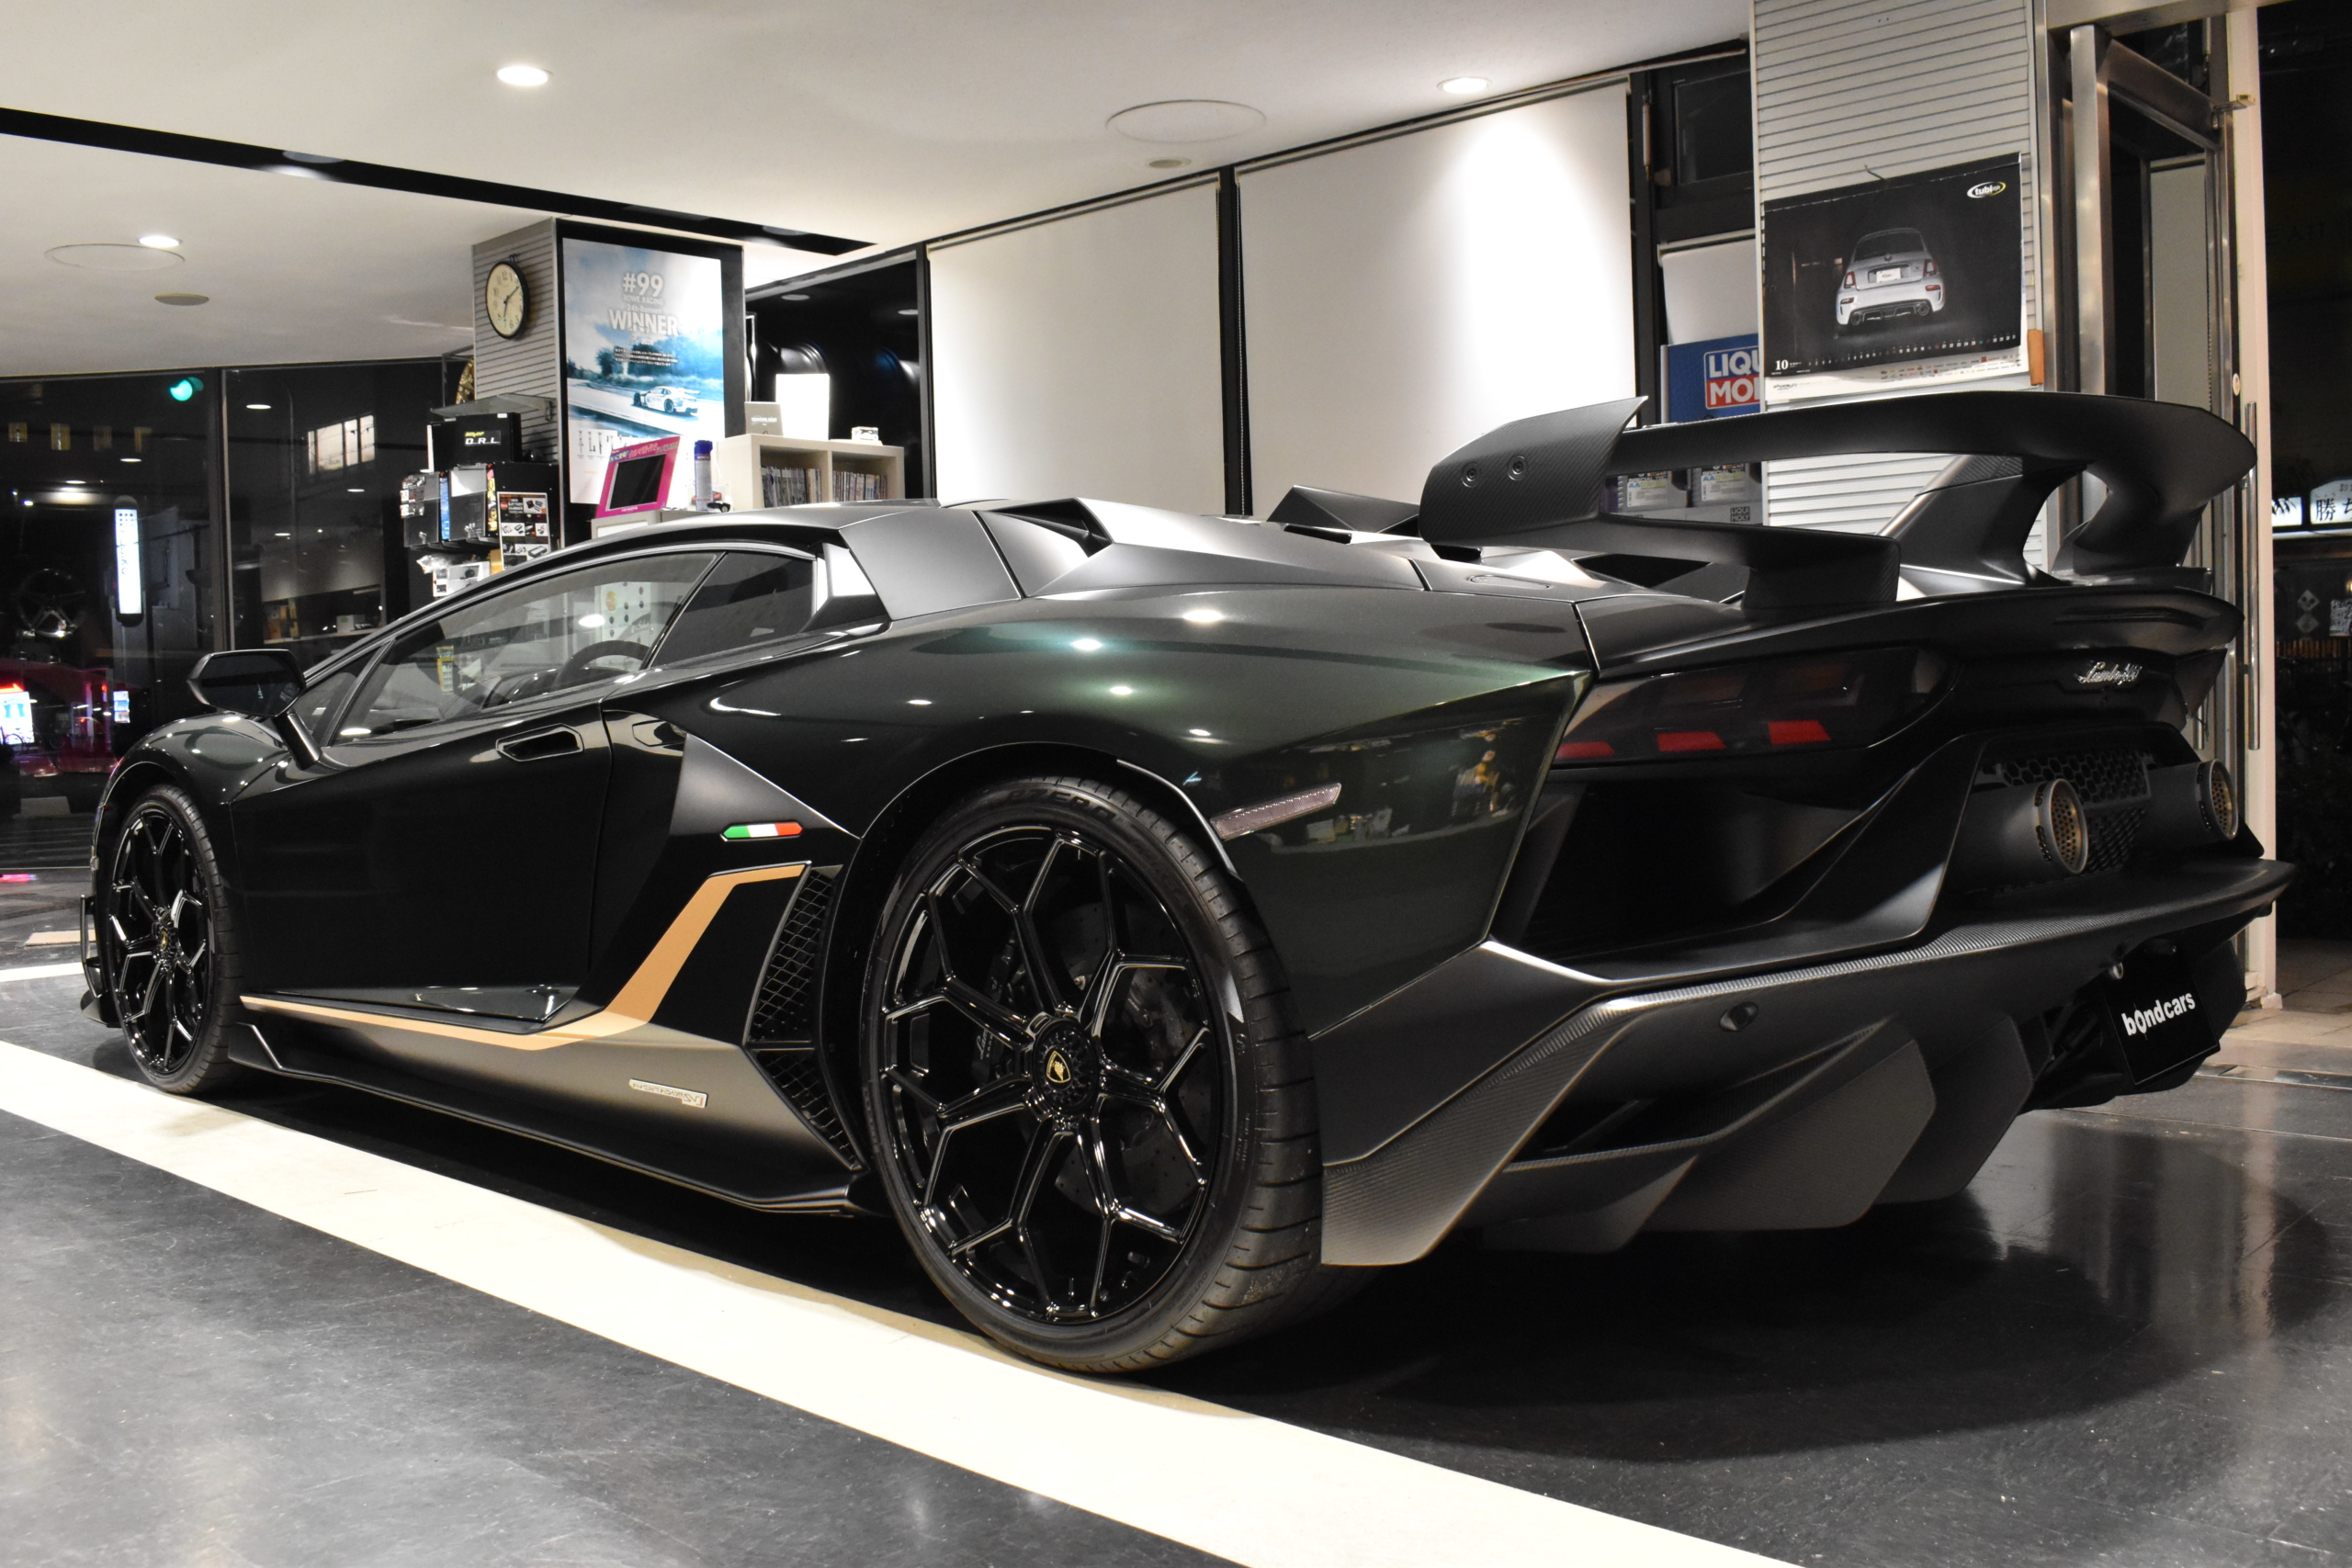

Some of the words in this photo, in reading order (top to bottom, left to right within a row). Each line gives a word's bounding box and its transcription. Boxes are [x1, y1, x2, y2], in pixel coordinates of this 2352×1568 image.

[623, 273, 663, 297] #99
[608, 309, 680, 337] WINNER
[1775, 359, 1789, 370] 10
